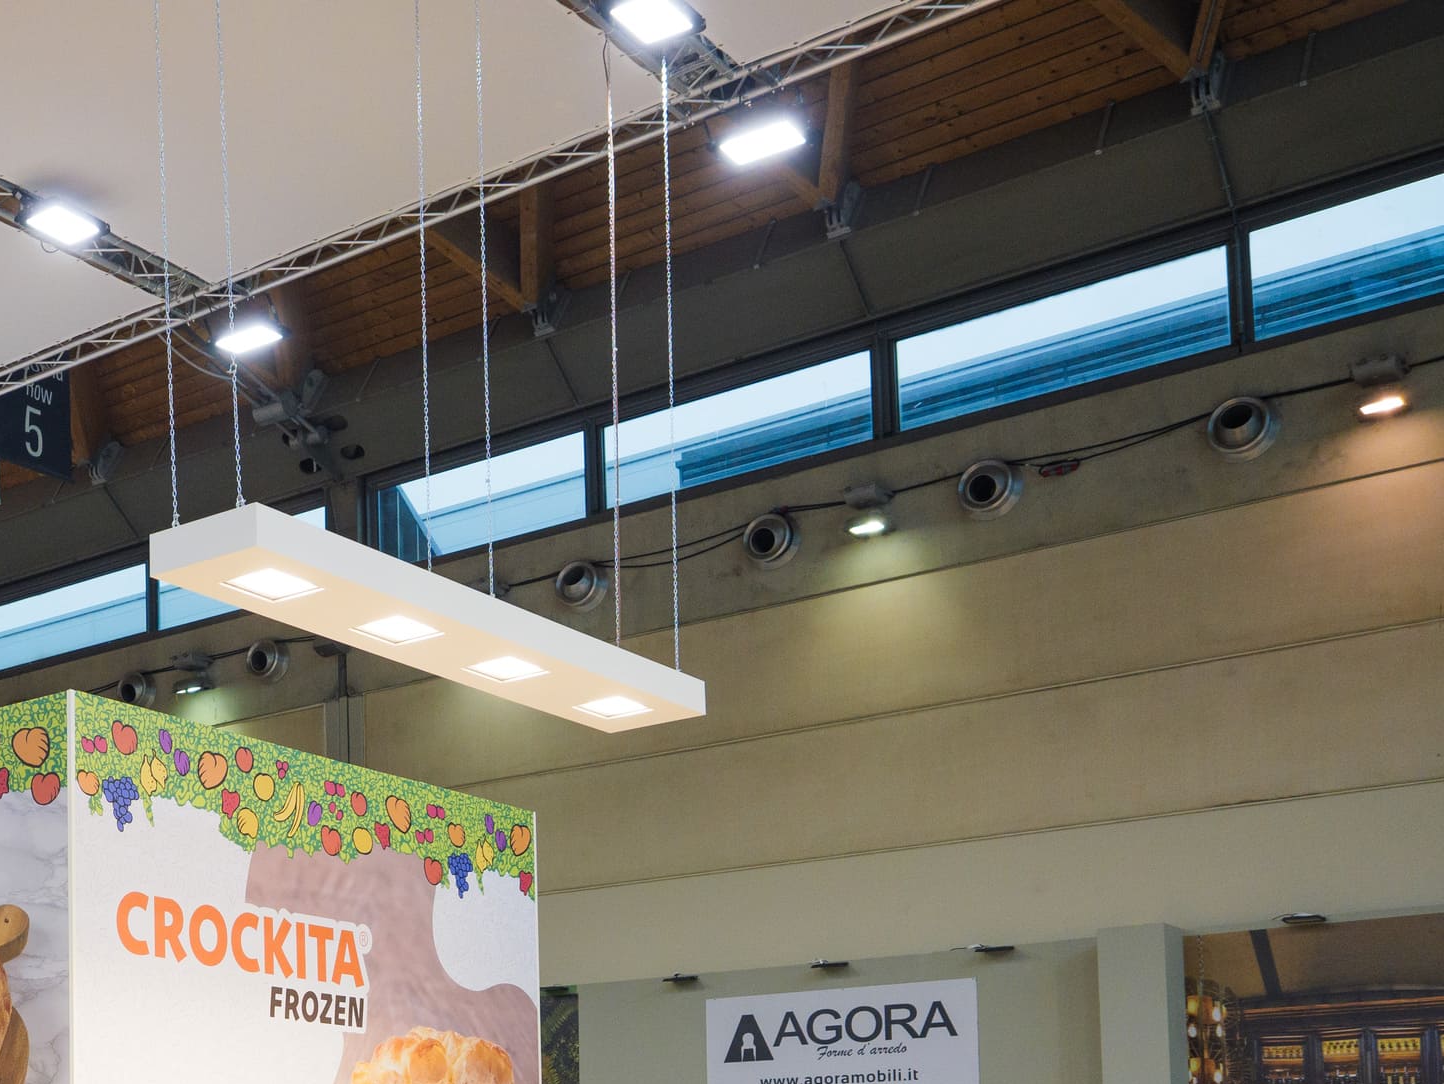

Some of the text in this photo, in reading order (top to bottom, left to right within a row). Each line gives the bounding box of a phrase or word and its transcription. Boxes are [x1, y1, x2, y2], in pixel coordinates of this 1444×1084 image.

[24, 405, 43, 458] 5
[269, 985, 365, 1029] FROZEN
[773, 1000, 958, 1047] AGORA
[816, 1045, 853, 1061] Forme
